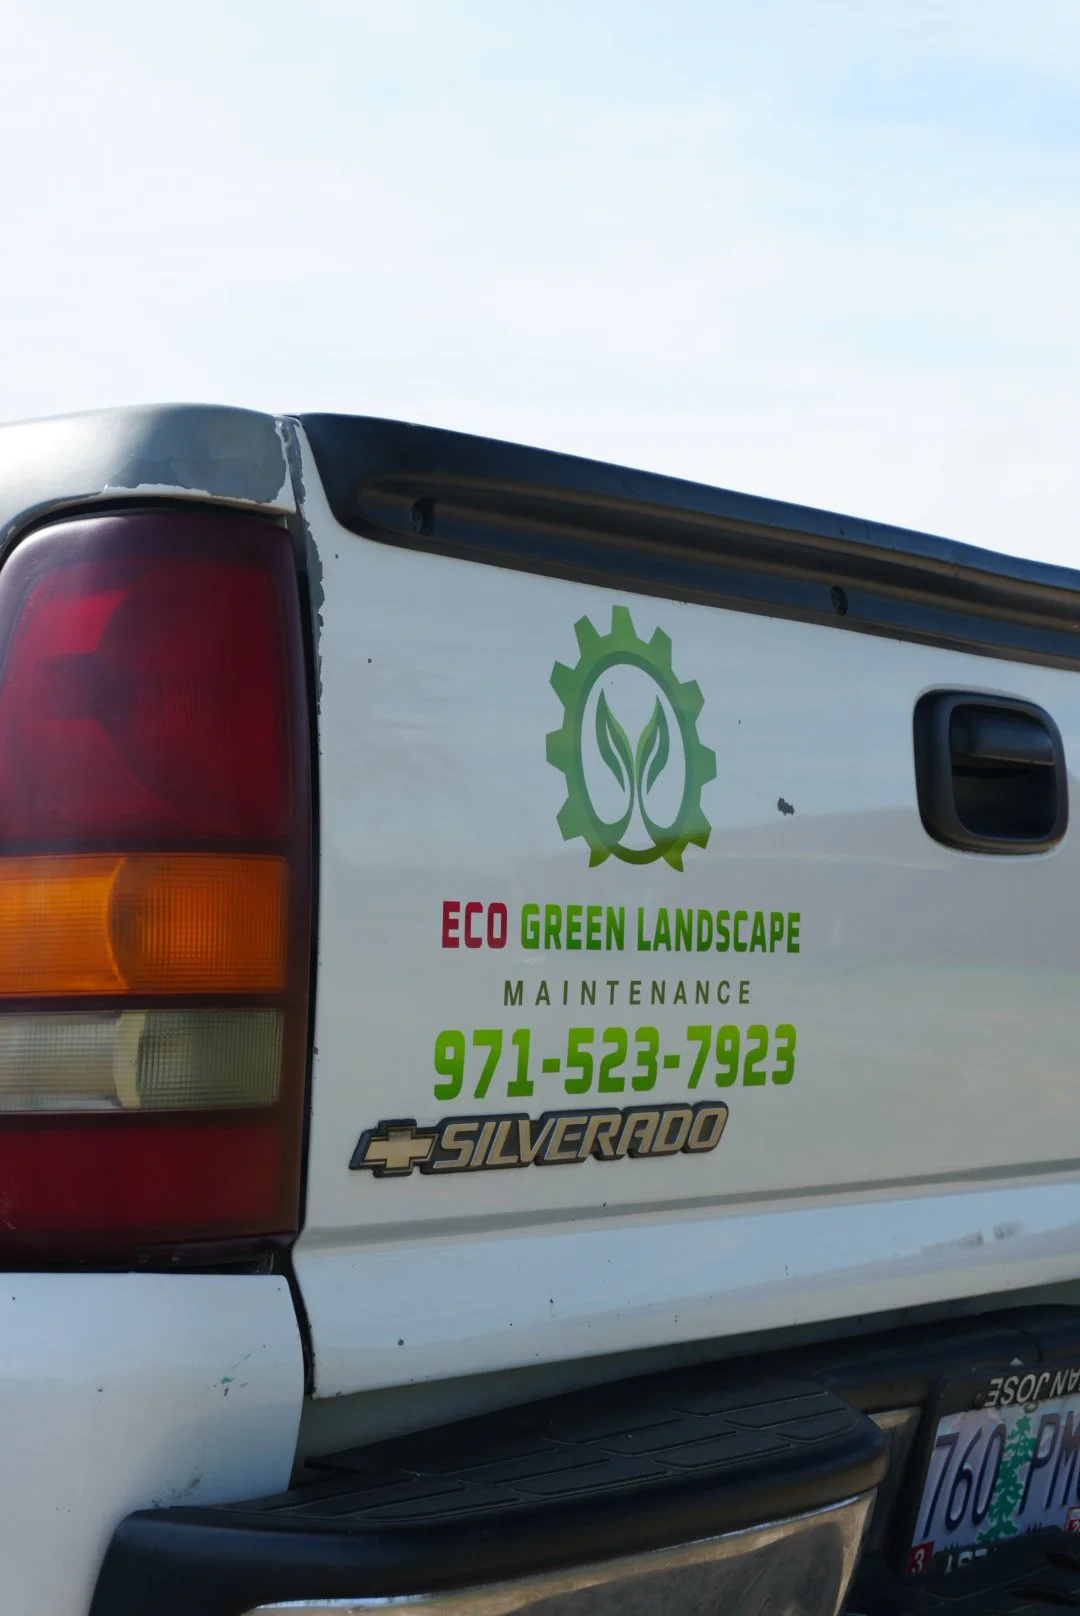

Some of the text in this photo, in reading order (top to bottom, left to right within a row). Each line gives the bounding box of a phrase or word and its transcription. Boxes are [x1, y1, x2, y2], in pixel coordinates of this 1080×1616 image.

[442, 900, 801, 953] ECO GREEN LANDSCAPE
[503, 980, 751, 1006] MAINTENANCE
[433, 1023, 797, 1101] 971-523-7923
[432, 1102, 728, 1169] SILVERADO
[984, 1368, 1080, 1407] AN JOSE
[923, 1410, 1080, 1539] 760 PM
